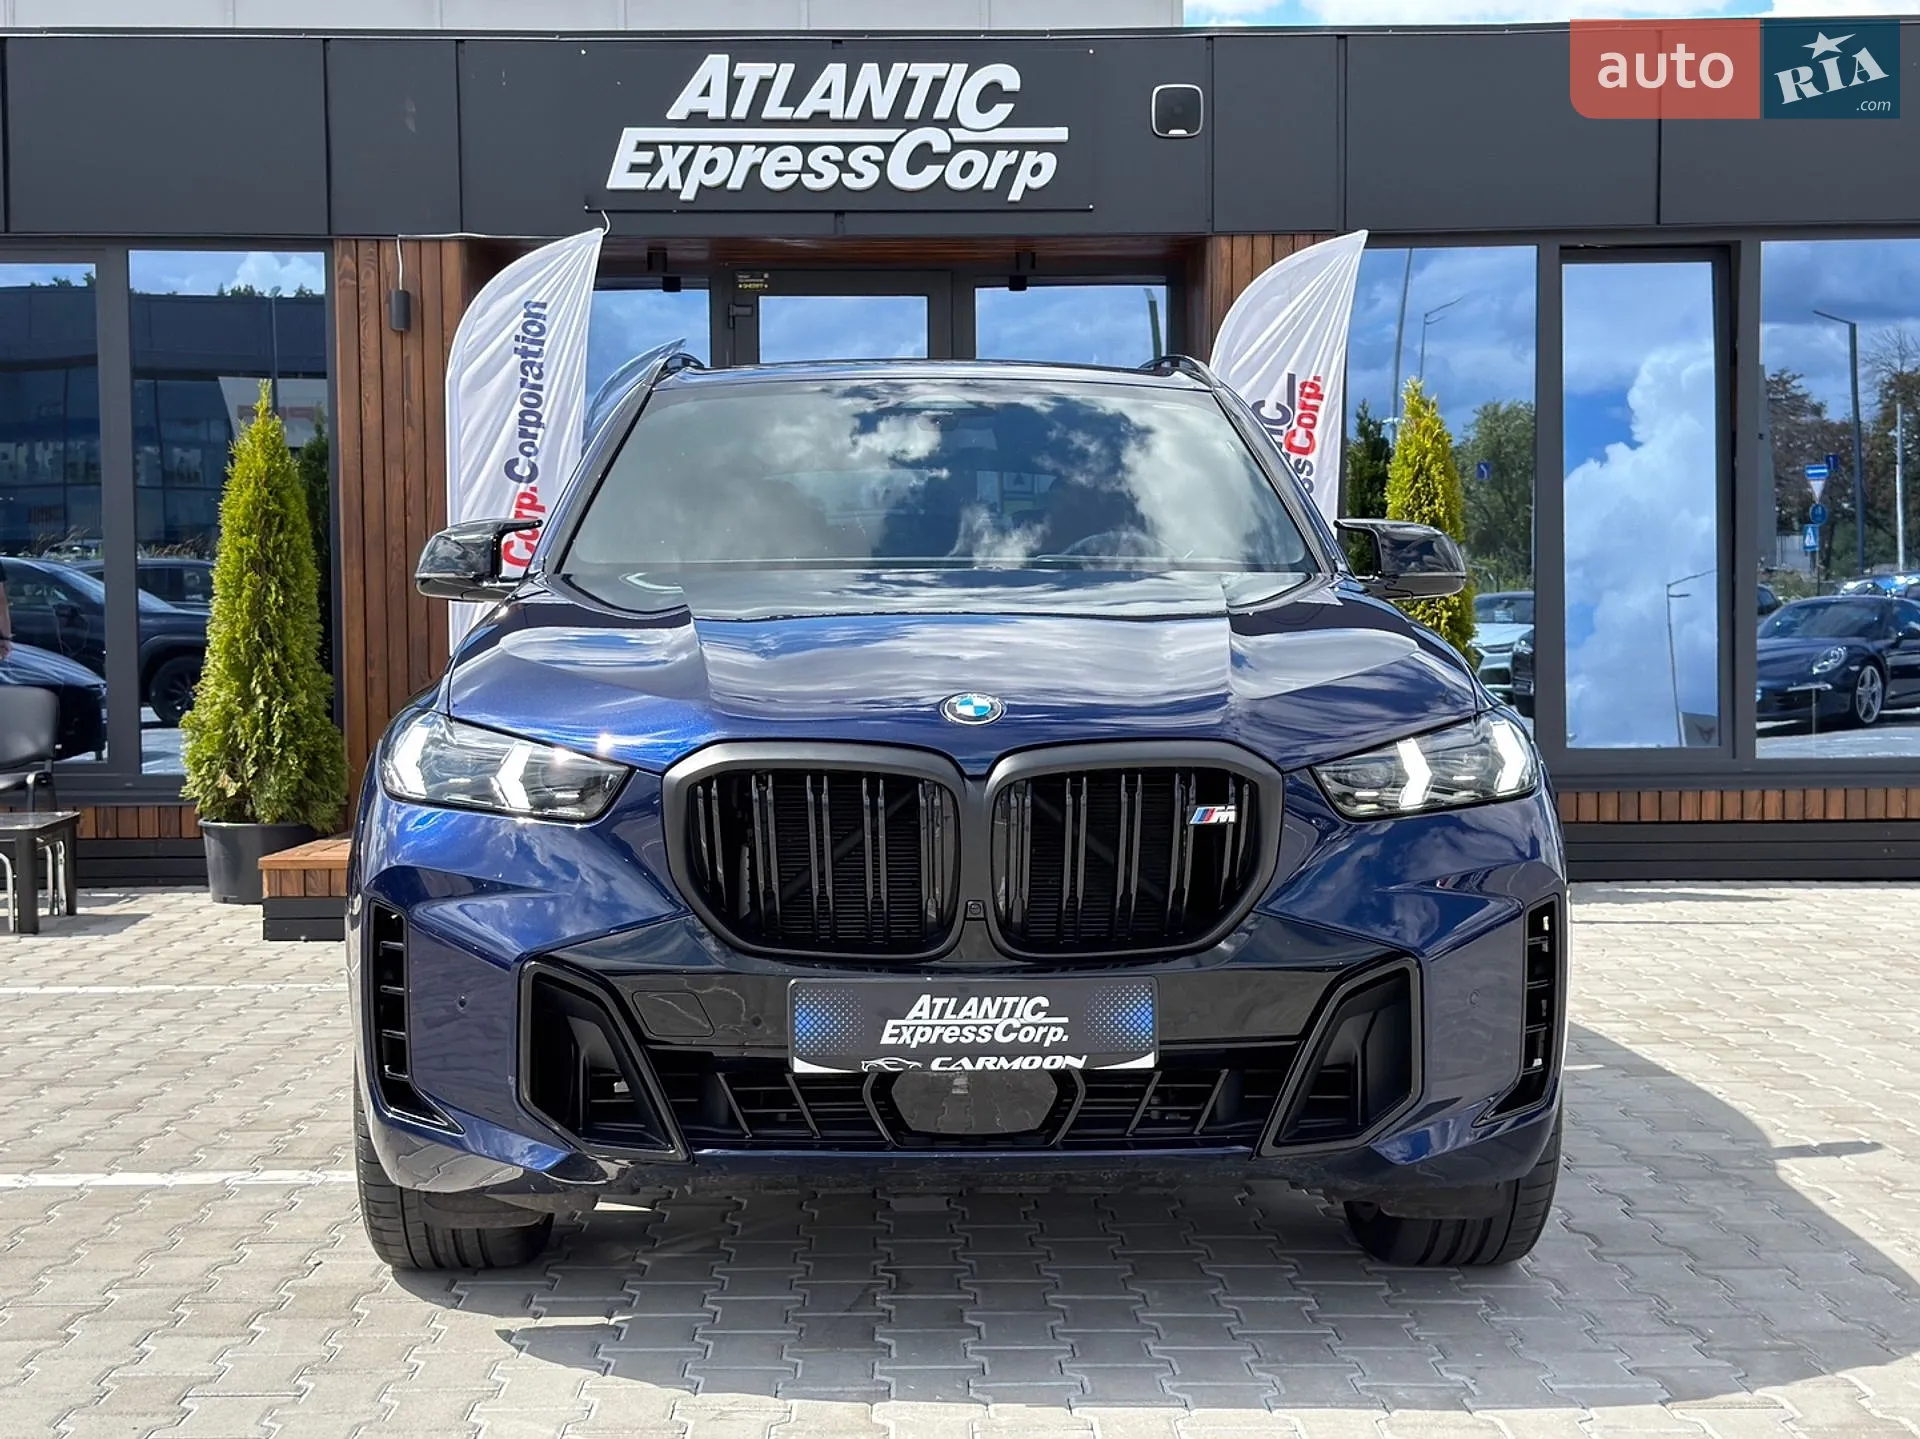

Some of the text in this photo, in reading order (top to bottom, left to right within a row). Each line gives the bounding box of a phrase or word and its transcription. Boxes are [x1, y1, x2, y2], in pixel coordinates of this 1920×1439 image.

[666, 53, 1022, 132] ATLANTIC
[606, 126, 1059, 202] ExpressCorp
[503, 299, 548, 485] Corporation
[880, 1019, 1069, 1048] ExpressCorp.
[905, 994, 1050, 1021] ATLANTIC
[930, 1055, 1087, 1071] CARMOON
